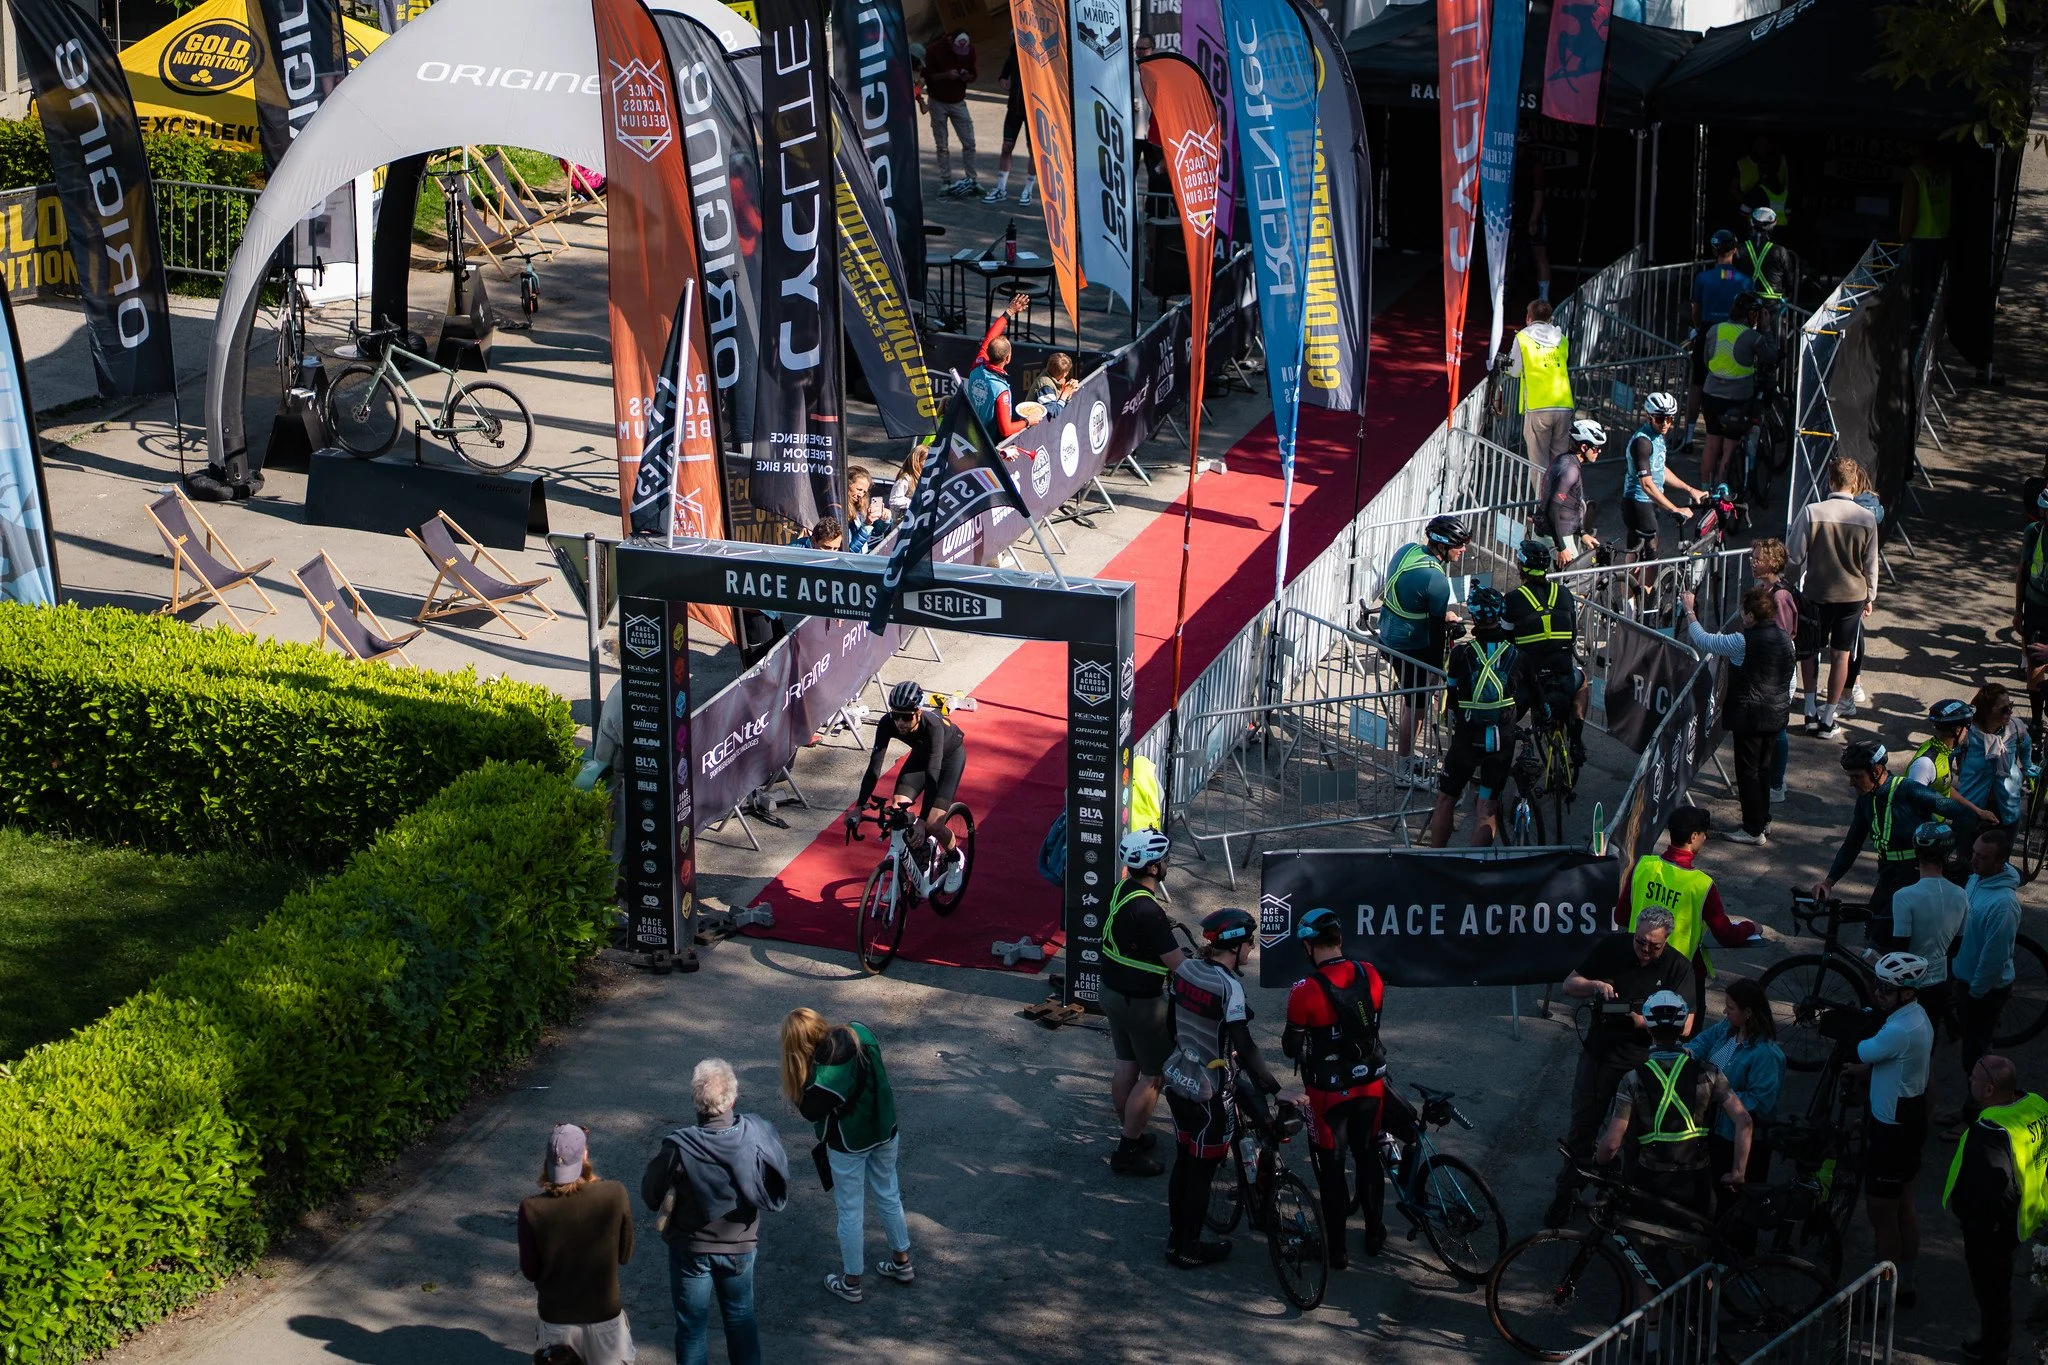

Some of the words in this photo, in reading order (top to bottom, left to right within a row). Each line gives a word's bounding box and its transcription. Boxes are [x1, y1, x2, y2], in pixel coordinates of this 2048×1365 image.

[184, 33, 251, 59] GOLD
[173, 51, 249, 73] NUTRITION
[725, 569, 788, 600] RACE
[797, 577, 877, 609] ACROS
[923, 594, 982, 616] SERIES
[634, 625, 651, 633] RACE
[631, 631, 655, 640] ACROSS
[630, 637, 656, 646] BELGIUM
[1084, 671, 1100, 679] RACE
[1080, 677, 1105, 686] ACROSS
[1079, 684, 1106, 693] BELGIUM
[628, 690, 661, 700] PRYMAHL
[631, 704, 659, 714] CYCLITE
[633, 718, 658, 729] wilma
[1075, 739, 1109, 749] PRYMAHL
[1077, 753, 1107, 763] CYCLITE
[1079, 768, 1105, 780] wilma
[1077, 787, 1107, 798] ARLON
[1645, 881, 1682, 909] STAFF
[641, 916, 662, 927] RACE
[1357, 904, 1445, 936] RACE
[1459, 902, 1597, 936] ACROSS
[637, 924, 667, 936] ACROSS
[1261, 922, 1281, 931] PAIN
[1079, 972, 1100, 983] RACE
